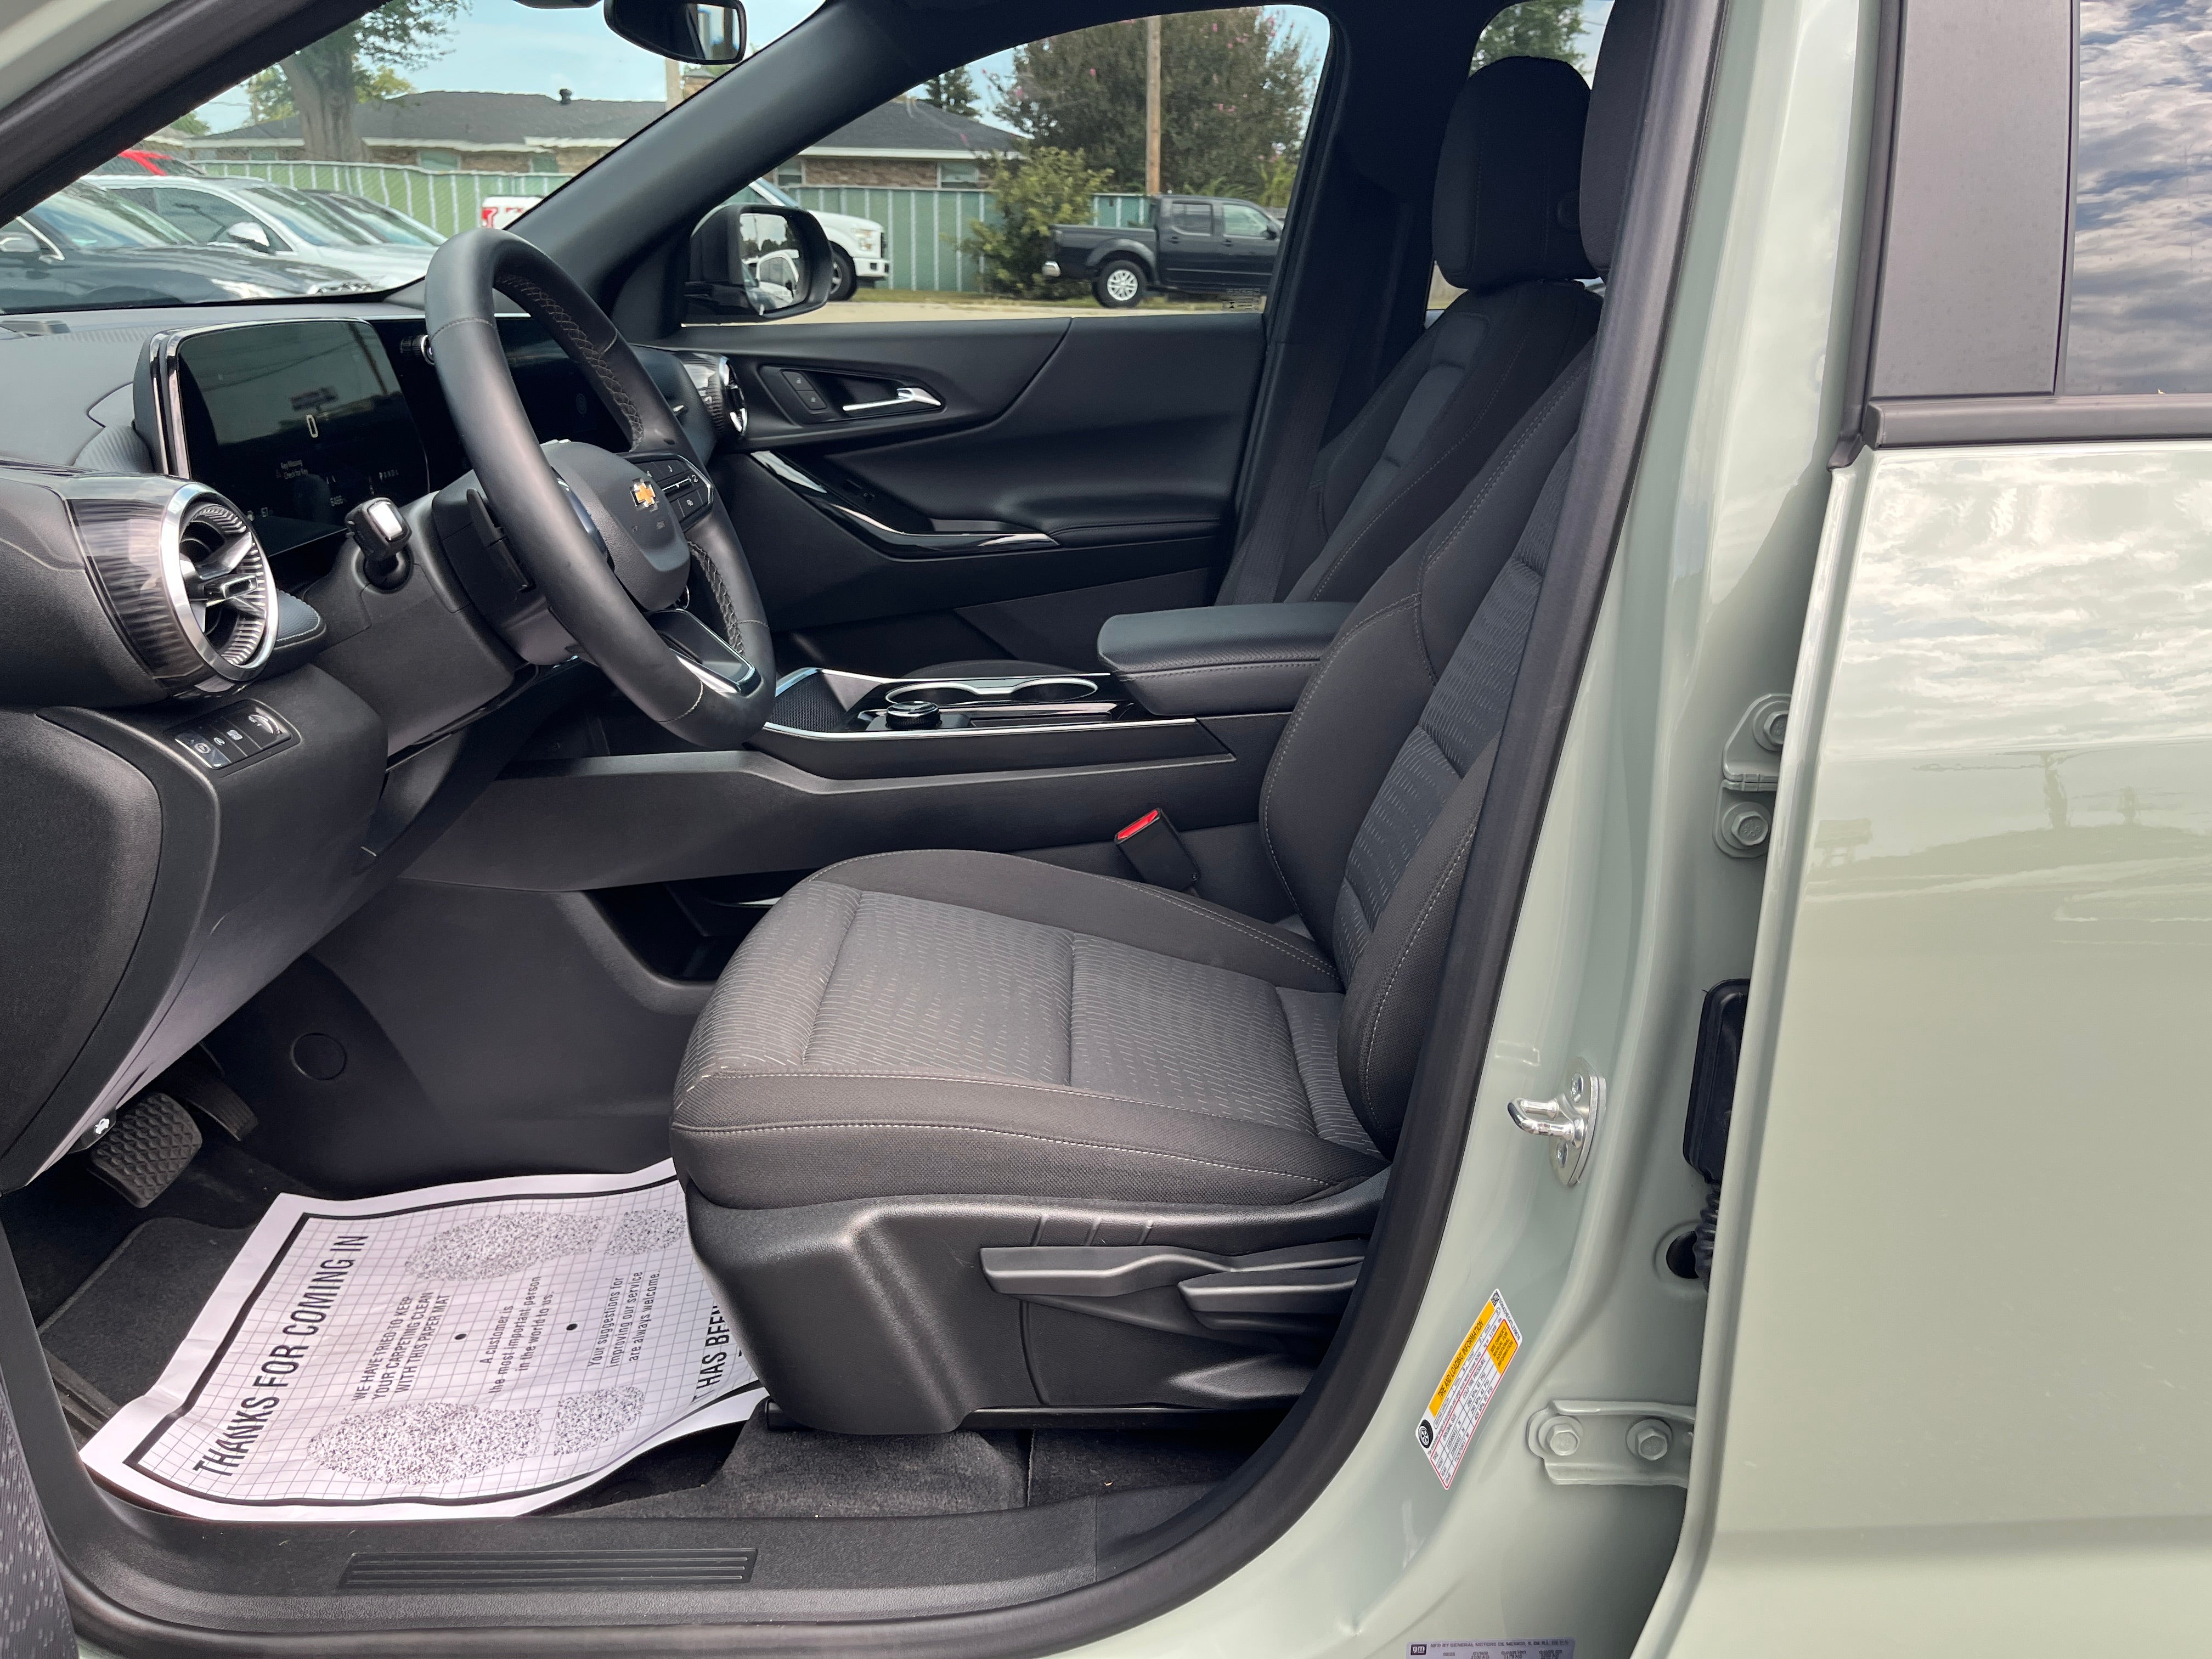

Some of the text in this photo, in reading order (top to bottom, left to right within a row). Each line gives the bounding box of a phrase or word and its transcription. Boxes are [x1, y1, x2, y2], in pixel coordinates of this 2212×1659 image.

[306, 414, 318, 438] 0
[351, 1296, 413, 1401] WE HAVE TRIED TO KEEP
[371, 1293, 433, 1400] YOUR CARPETING CLEAN
[394, 1295, 450, 1393] WITH THIS PAPER MAT
[486, 1314, 509, 1355] customer
[500, 1305, 514, 1314] is
[488, 1276, 541, 1393] the most important person
[520, 1346, 535, 1360] the
[528, 1318, 545, 1343] world
[536, 1308, 549, 1317] to
[587, 1278, 624, 1367] Your suggestions for
[606, 1272, 642, 1368] improving our service
[629, 1271, 660, 1361] are always welcome.
[193, 1236, 369, 1476] THANKS FOR COMING IN
[515, 1362, 530, 1371] in
[696, 1352, 727, 1389] HAS
[1437, 1319, 1483, 1400] TIRE AND LOADING INFORMATION
